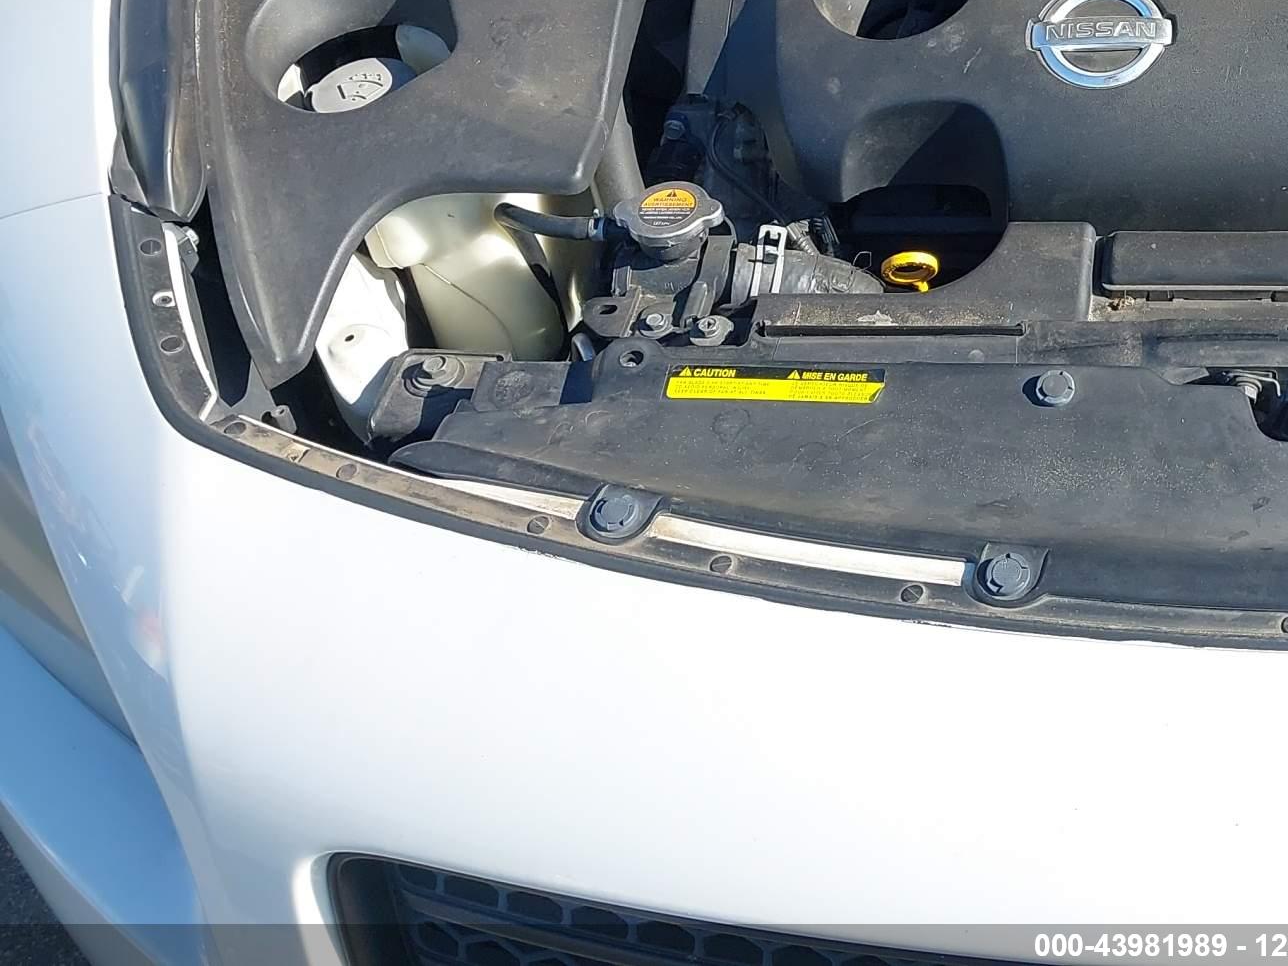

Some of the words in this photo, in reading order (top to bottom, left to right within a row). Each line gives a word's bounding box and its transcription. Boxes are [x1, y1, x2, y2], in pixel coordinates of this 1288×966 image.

[1046, 21, 1156, 41] NISSAN
[693, 368, 737, 377] CAUTION
[801, 371, 824, 380] MISE
[823, 372, 836, 381] EN
[837, 373, 868, 382] GARDE
